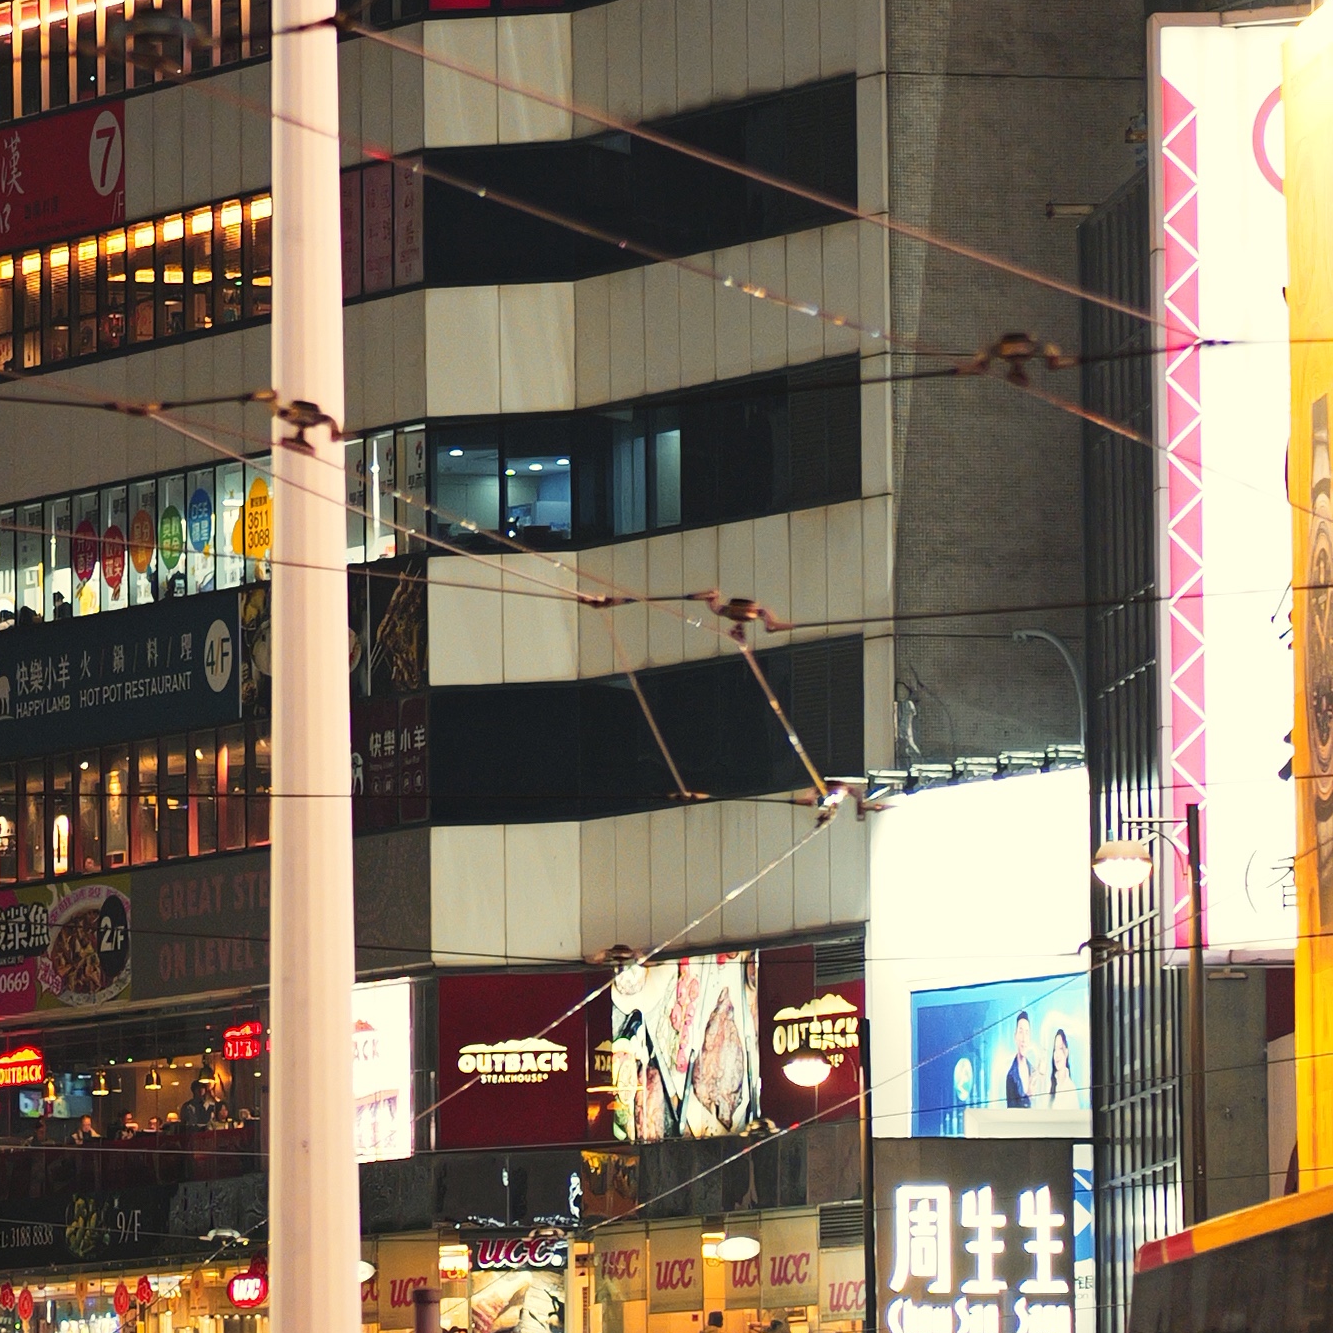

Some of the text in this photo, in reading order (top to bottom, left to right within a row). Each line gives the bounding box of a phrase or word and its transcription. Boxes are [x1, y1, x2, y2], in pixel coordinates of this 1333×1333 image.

[248, 509, 270, 530] 3611
[16, 653, 71, 696] 快樂小羊
[205, 636, 231, 676] 4/F
[16, 670, 193, 719] HAPPY LAMB HOT POT RESTAURANT
[158, 874, 225, 922] GREAT
[100, 915, 125, 953] 2/F
[158, 942, 187, 983] ON
[193, 929, 255, 980] LEVEL
[773, 1016, 860, 1056] OUTBACK
[458, 1052, 569, 1074] OUTBACK
[480, 1073, 545, 1085] STEAKHOUSE
[116, 1209, 142, 1245] 9/F
[889, 1185, 1070, 1294] 周生生
[656, 1257, 695, 1290] UCC
[770, 1252, 811, 1286] UCC
